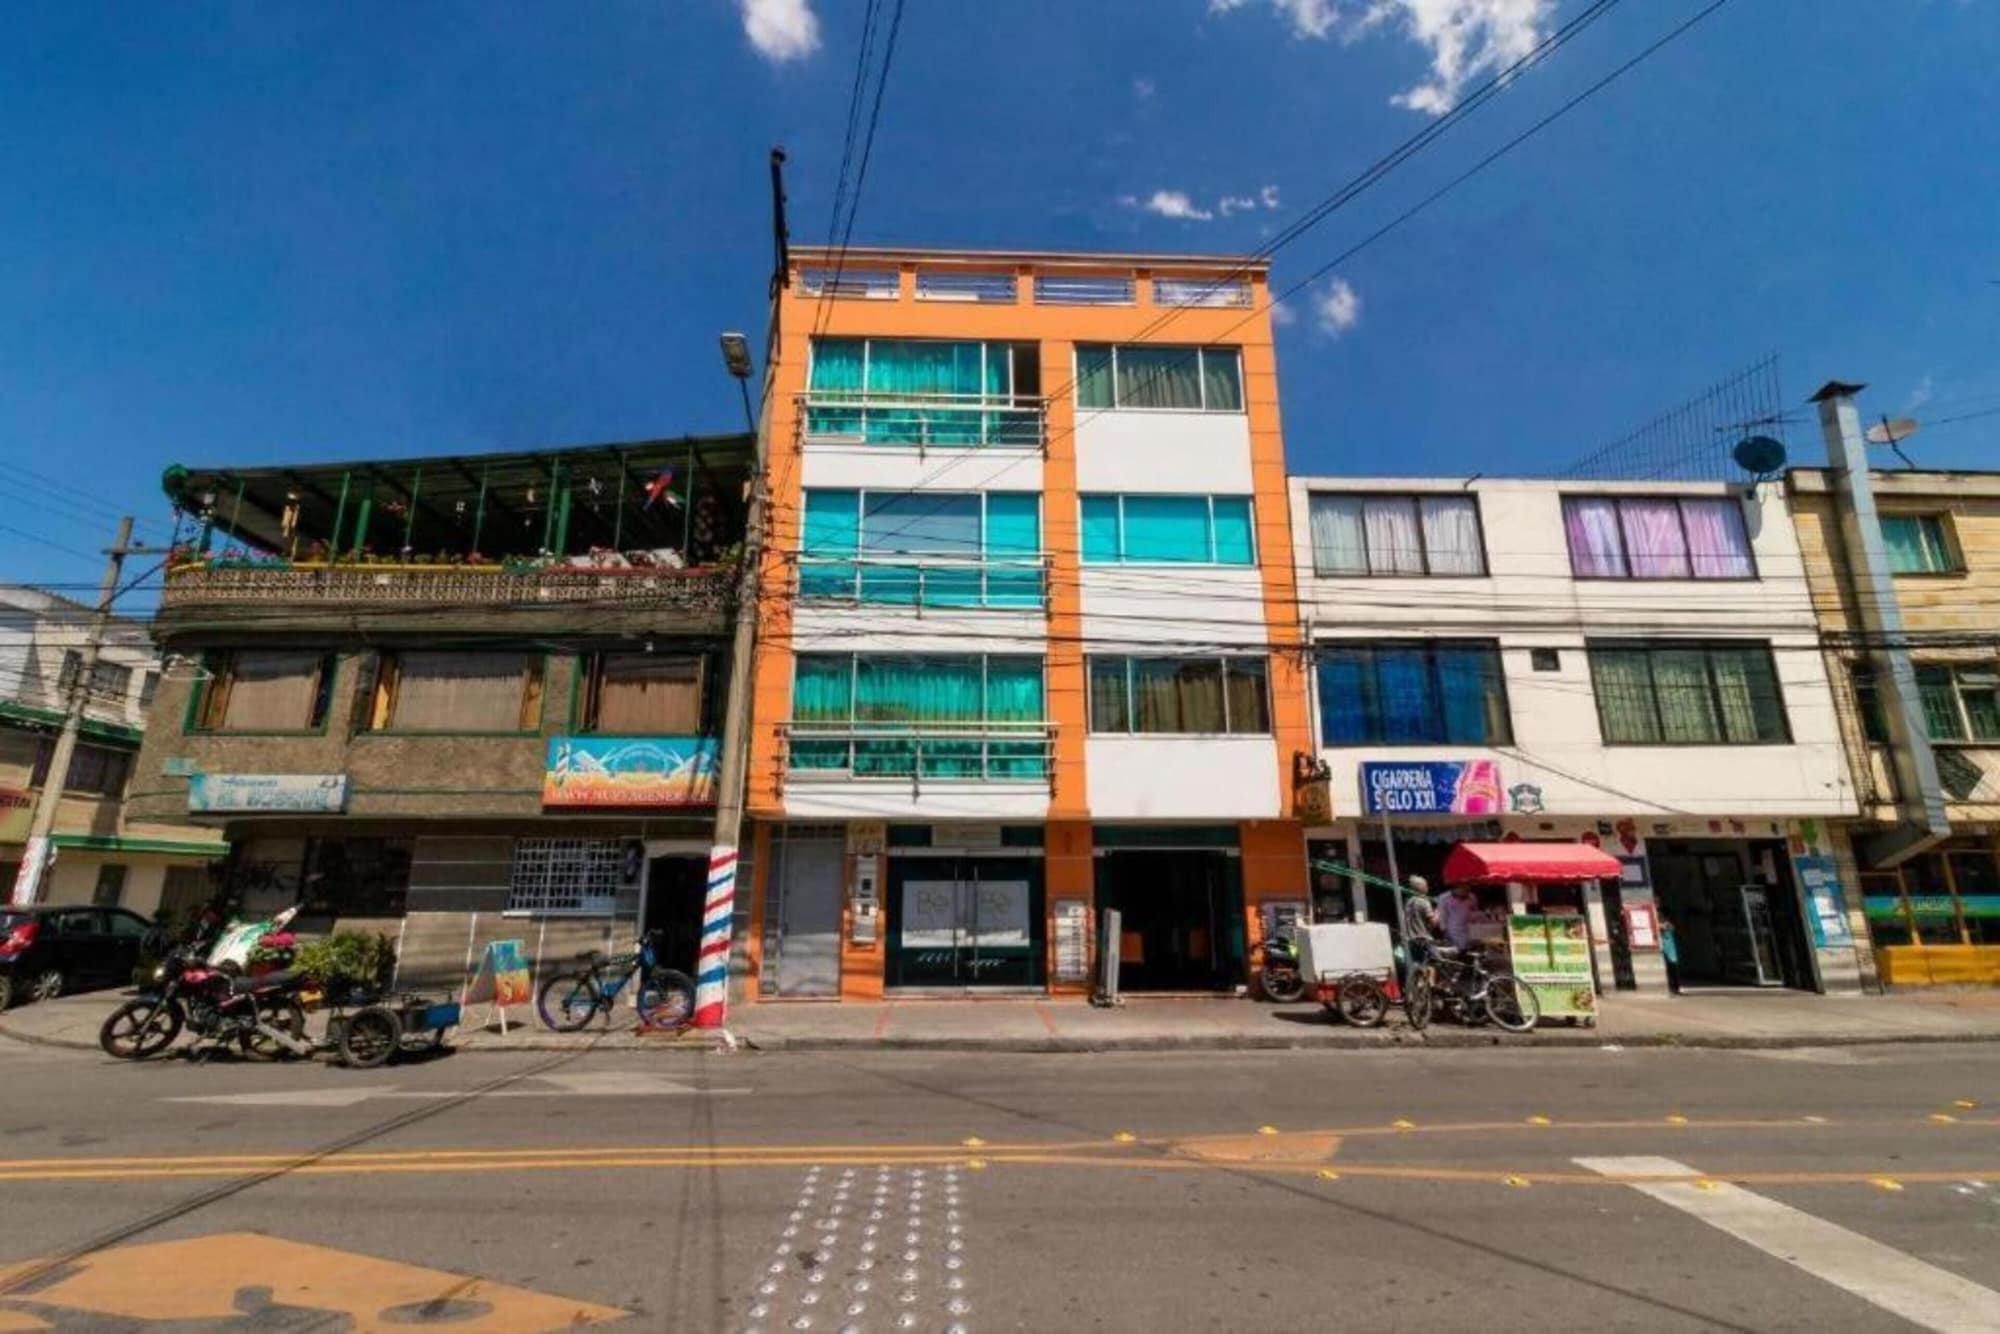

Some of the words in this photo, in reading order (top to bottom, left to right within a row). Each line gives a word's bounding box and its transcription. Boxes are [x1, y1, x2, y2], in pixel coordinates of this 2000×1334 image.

[1371, 766, 1433, 789] CIGARRERÍA
[1374, 790, 1413, 810] SGLO
[1414, 790, 1436, 810] XXI
